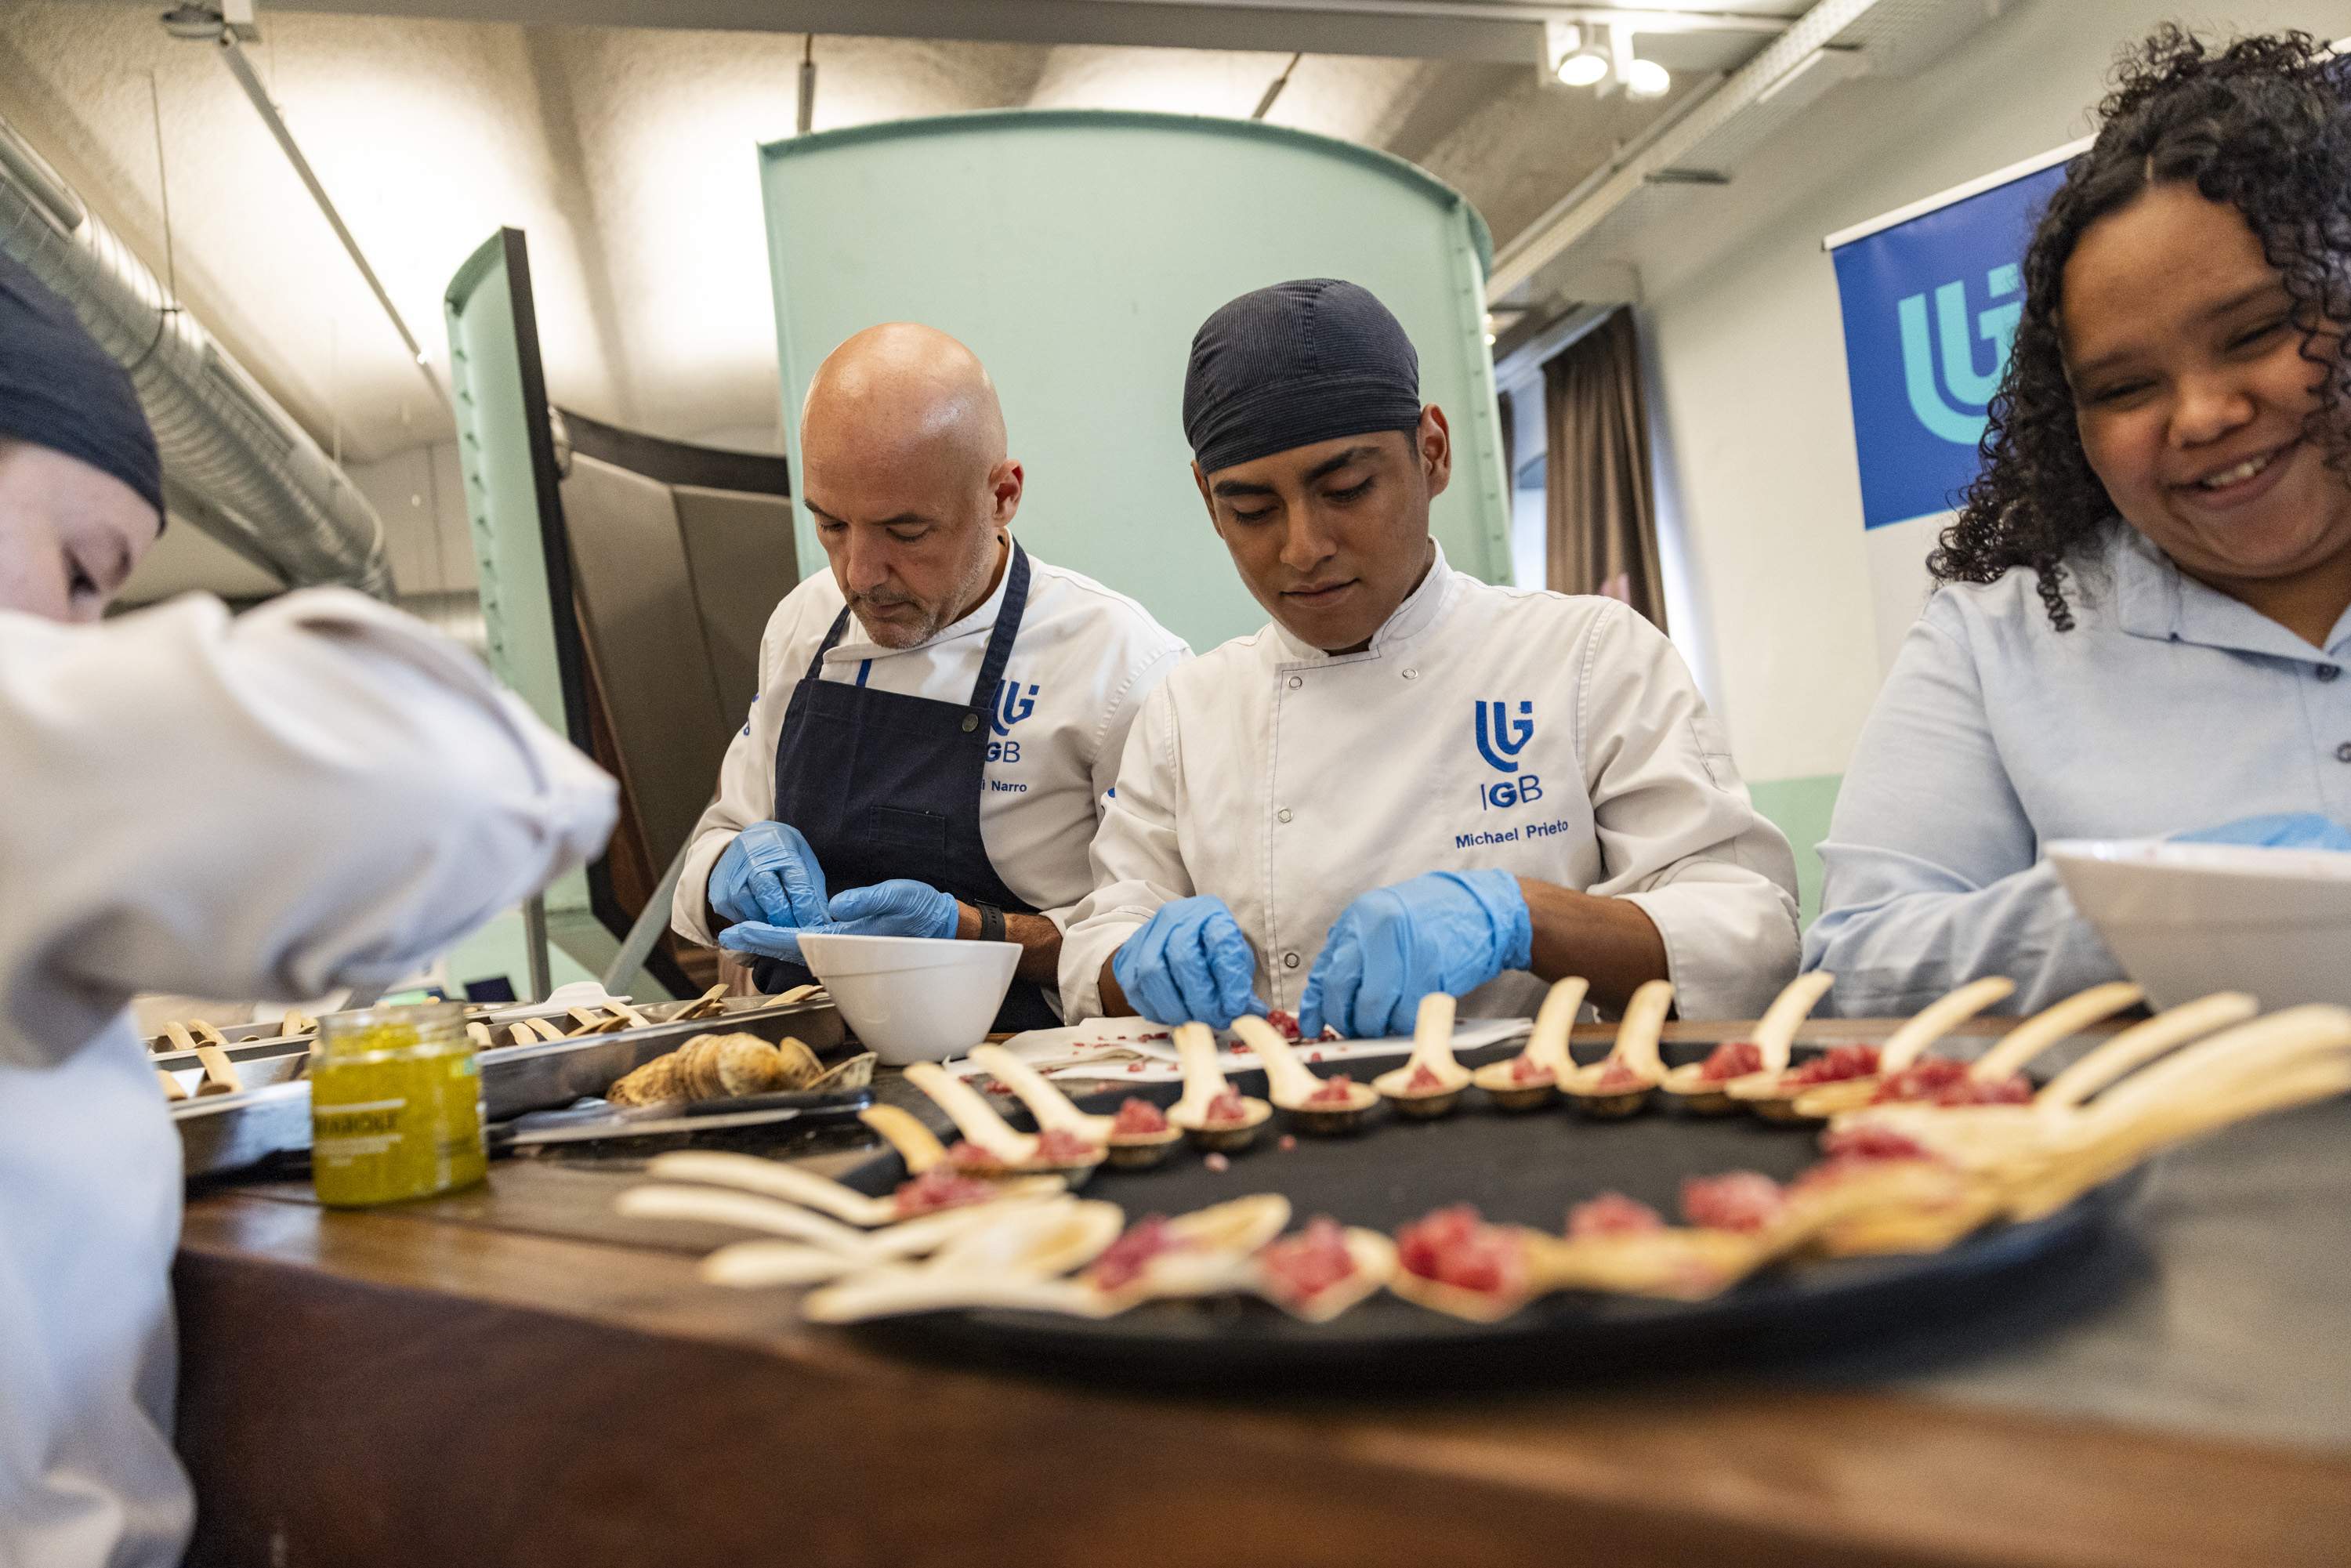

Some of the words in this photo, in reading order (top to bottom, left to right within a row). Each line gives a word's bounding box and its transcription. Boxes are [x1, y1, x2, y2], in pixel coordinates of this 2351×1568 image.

[984, 741, 1020, 763] GB
[991, 780, 1027, 792] Narro
[1480, 774, 1543, 811] IGB
[1455, 827, 1519, 849] Michael
[1526, 820, 1569, 838] Prieto
